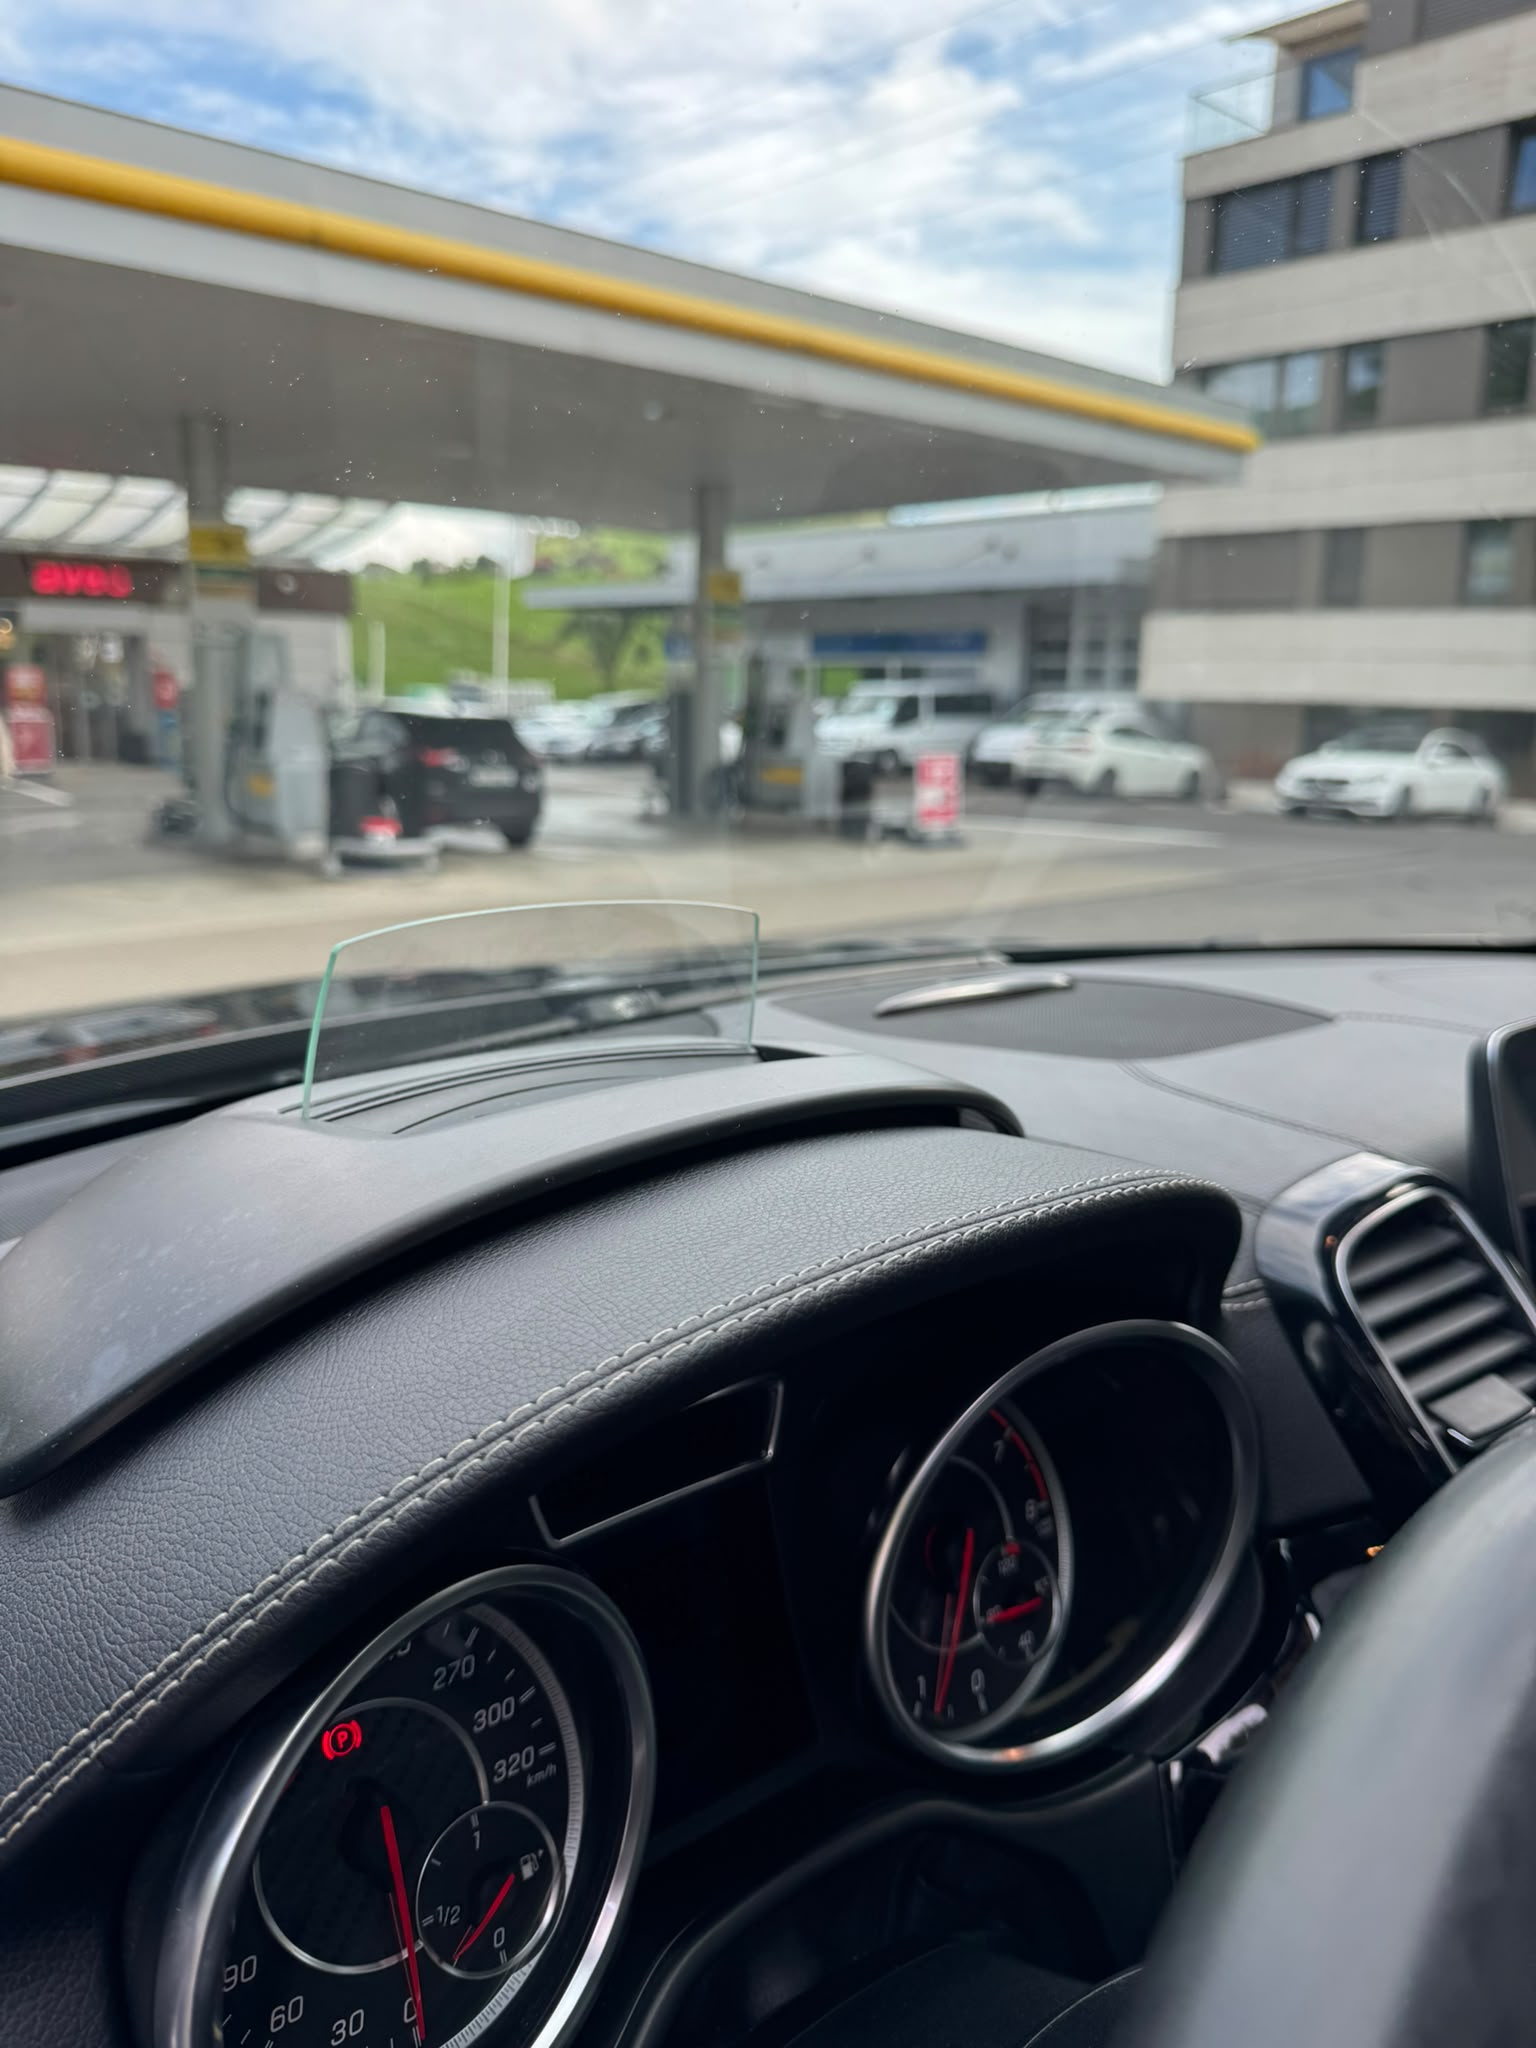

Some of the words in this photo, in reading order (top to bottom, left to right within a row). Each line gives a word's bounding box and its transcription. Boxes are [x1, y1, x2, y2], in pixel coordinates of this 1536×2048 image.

[434, 1655, 475, 1690] 270
[474, 1696, 515, 1733] 300
[494, 1746, 534, 1783] 320
[527, 1763, 556, 1788] km/h
[473, 1831, 480, 1850] 1
[436, 1905, 460, 1927] 1/2
[494, 1927, 505, 1948] 0
[223, 1955, 257, 1992] 90
[270, 1996, 303, 2033] 60
[331, 2009, 364, 2046] 30
